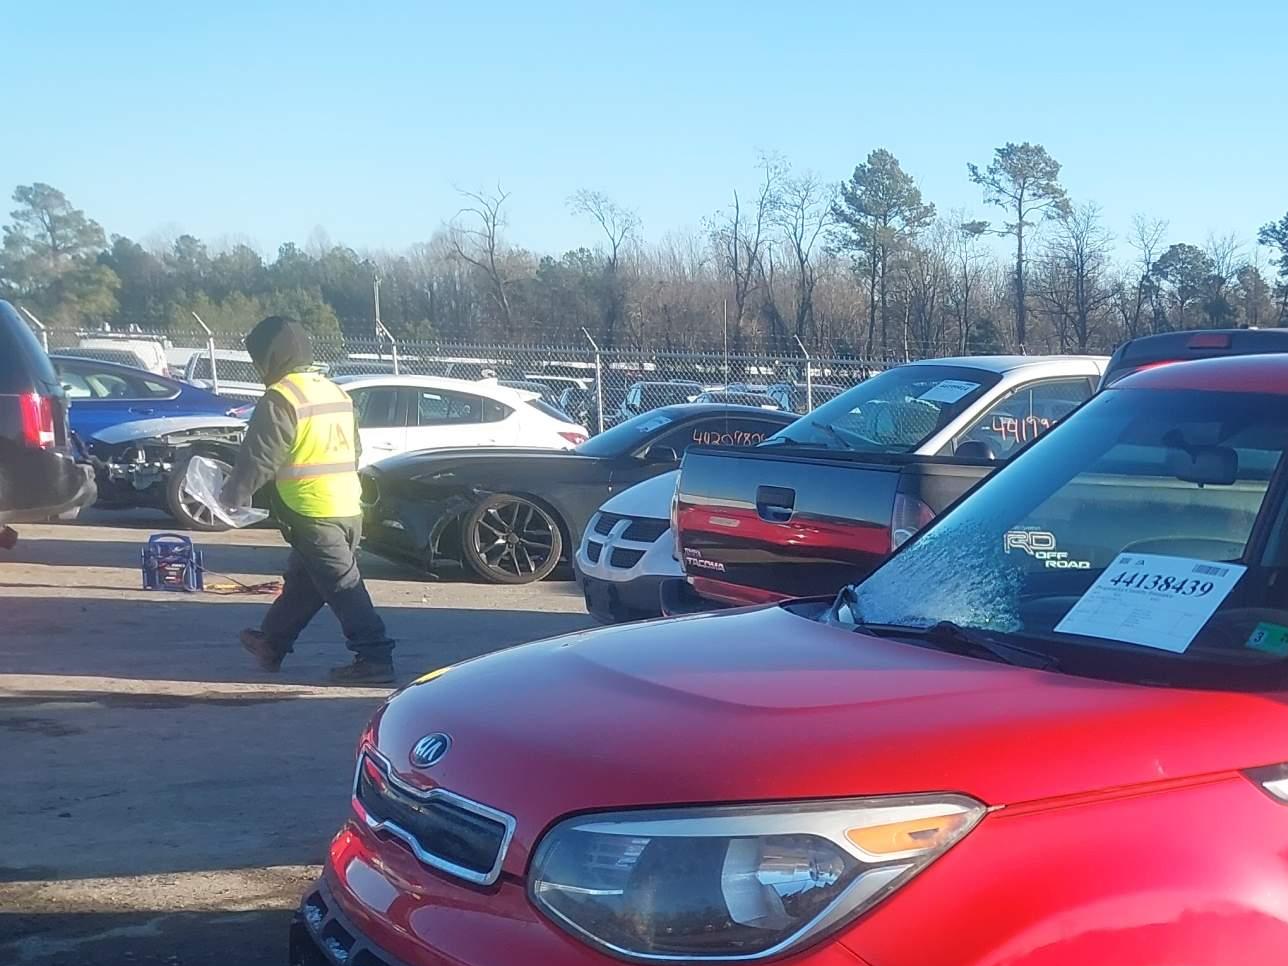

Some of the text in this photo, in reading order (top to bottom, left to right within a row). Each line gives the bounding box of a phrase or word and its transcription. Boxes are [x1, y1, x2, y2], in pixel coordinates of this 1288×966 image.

[1035, 551, 1068, 560] OFF
[686, 557, 726, 573] TACOMA
[1045, 560, 1091, 569] ROAD
[1110, 571, 1214, 598] 44138439
